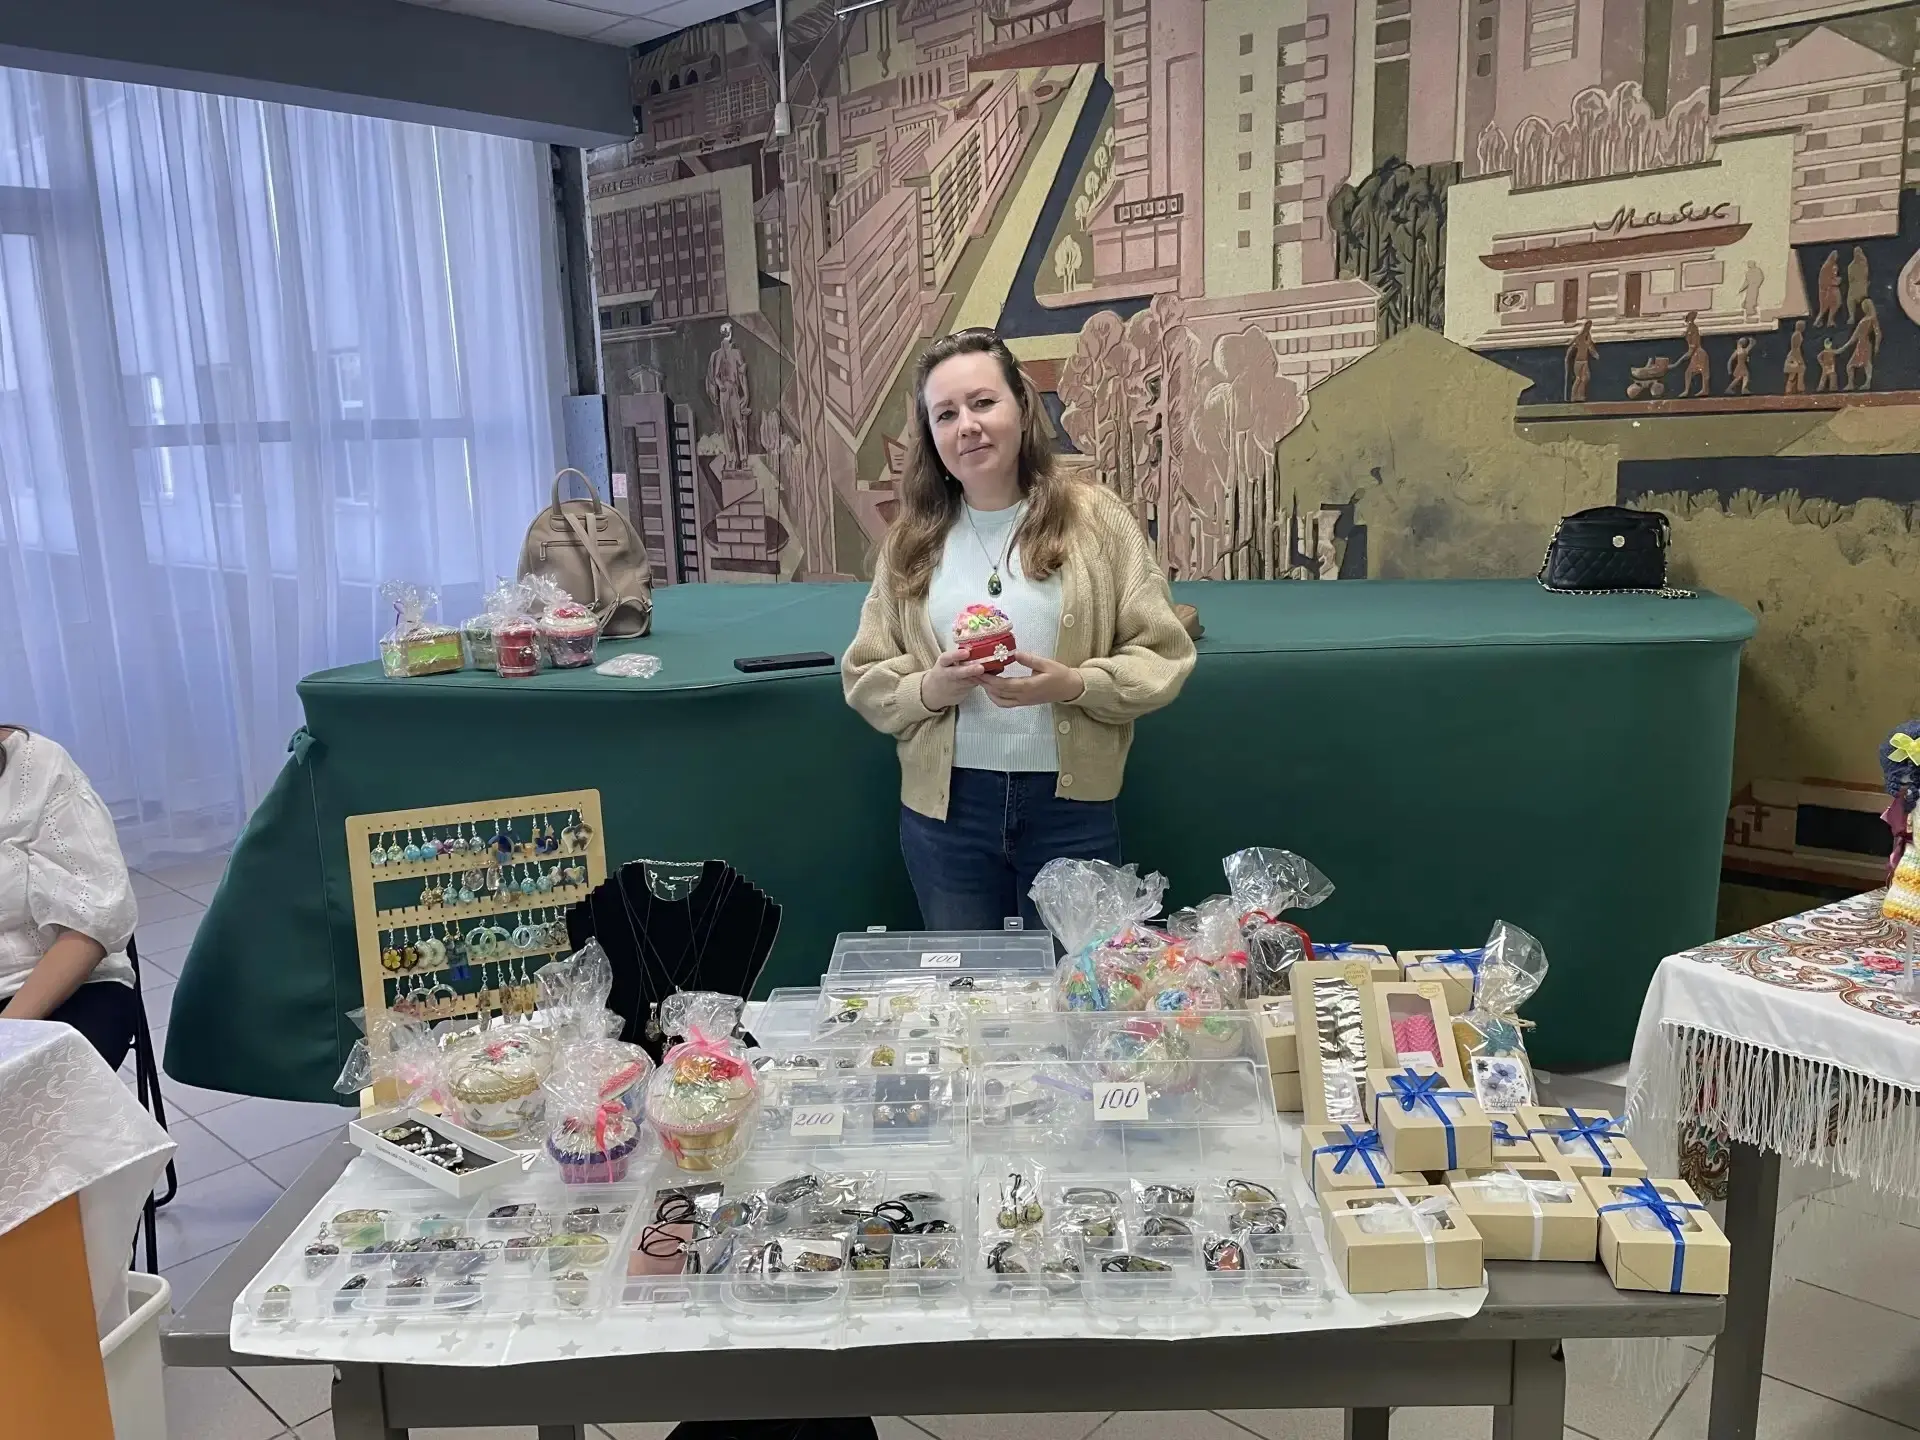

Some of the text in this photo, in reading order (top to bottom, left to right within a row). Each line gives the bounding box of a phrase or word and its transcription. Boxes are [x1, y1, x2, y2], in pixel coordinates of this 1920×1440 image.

[1593, 200, 1731, 236] Маяк
[927, 955, 959, 964] 100
[1099, 1087, 1140, 1110] 100
[793, 1112, 836, 1127] 200
